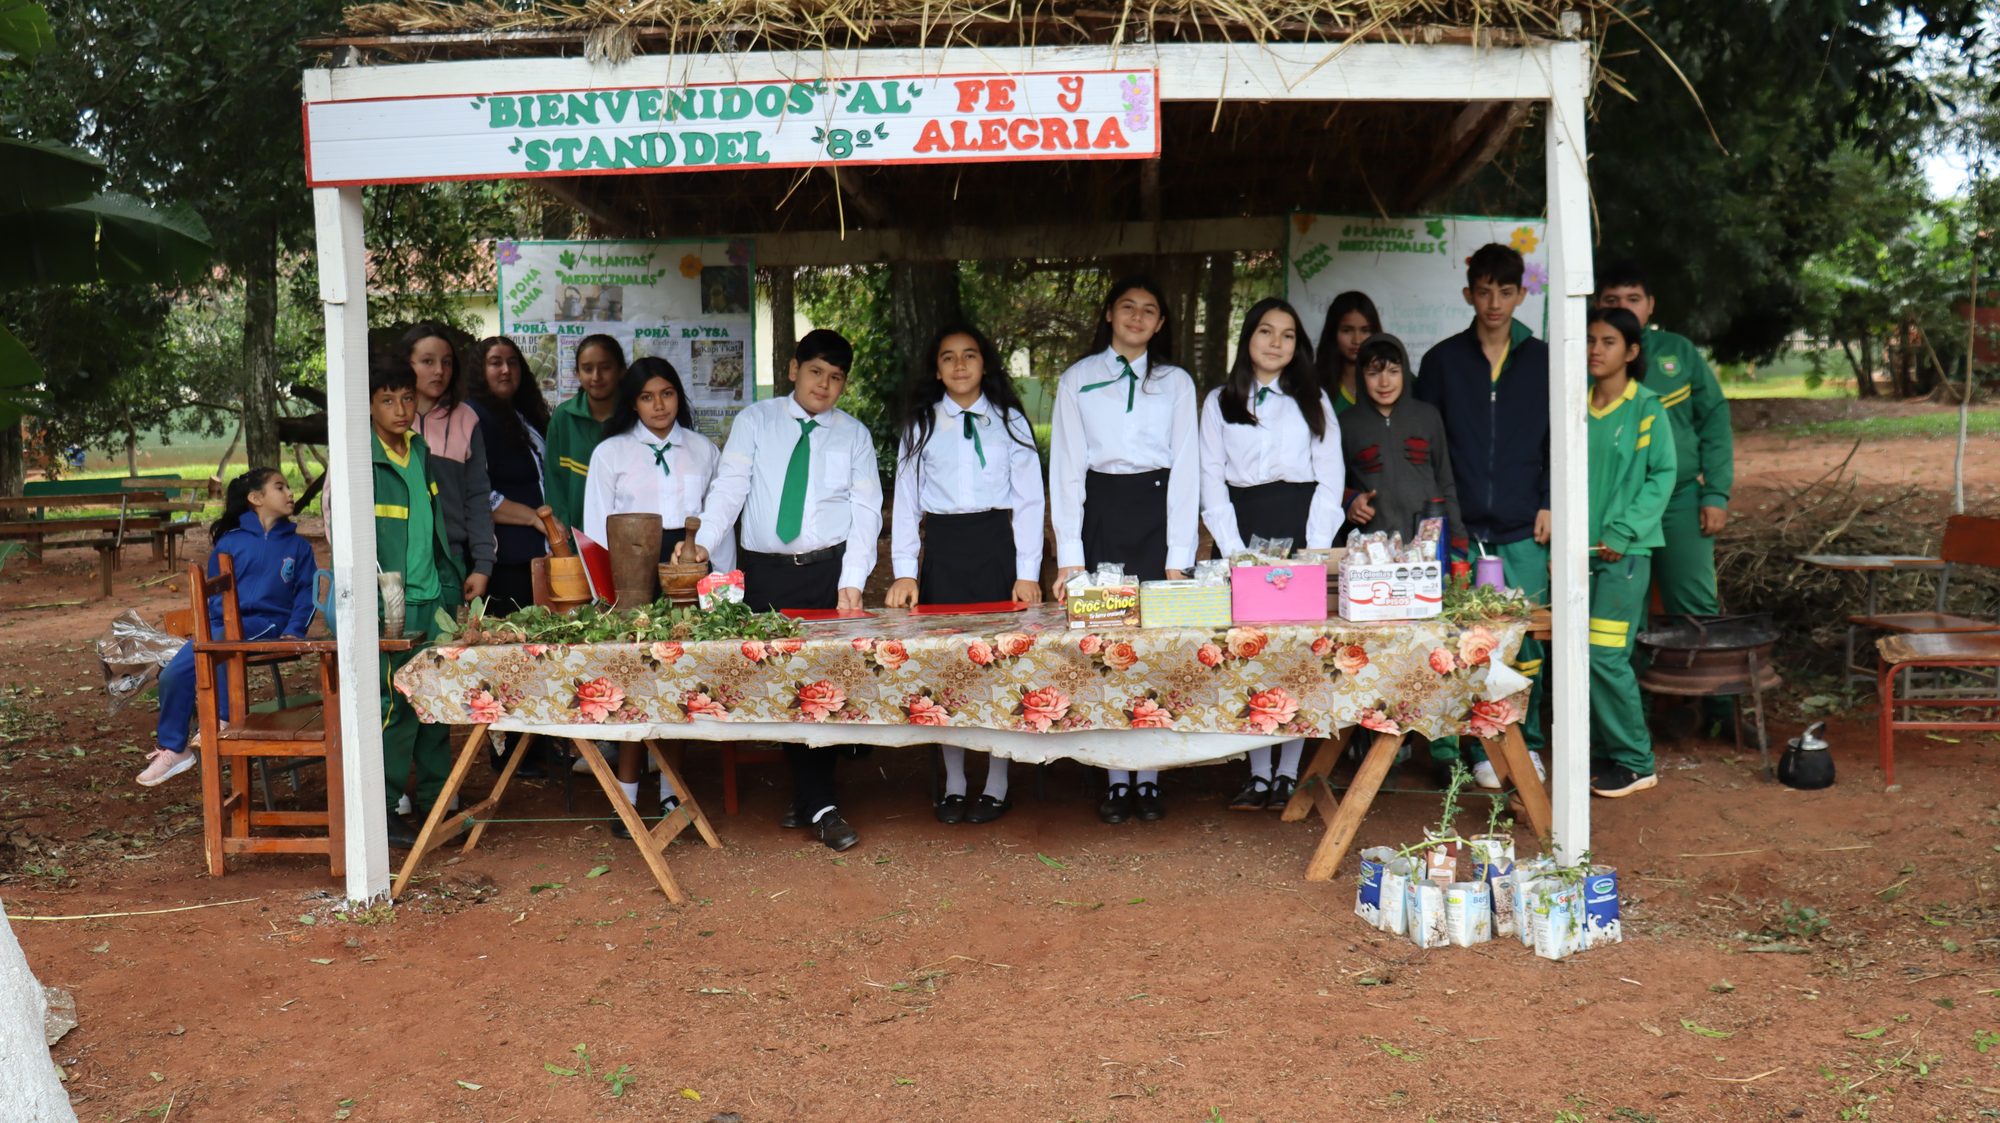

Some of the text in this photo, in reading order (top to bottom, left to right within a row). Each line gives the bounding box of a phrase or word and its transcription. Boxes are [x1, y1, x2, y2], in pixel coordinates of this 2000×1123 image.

[954, 78, 1017, 113] FE
[488, 81, 912, 128] BIENVENIDOS AL
[913, 116, 1130, 152] ALEGRIA
[525, 132, 677, 171] STAND
[679, 130, 770, 166] DEL
[1353, 226, 1415, 239] PLANTAS
[590, 255, 648, 267] PLANTAS
[561, 273, 657, 285] MEDICINALES
[557, 324, 585, 335] AKU
[519, 345, 538, 354] ALLO
